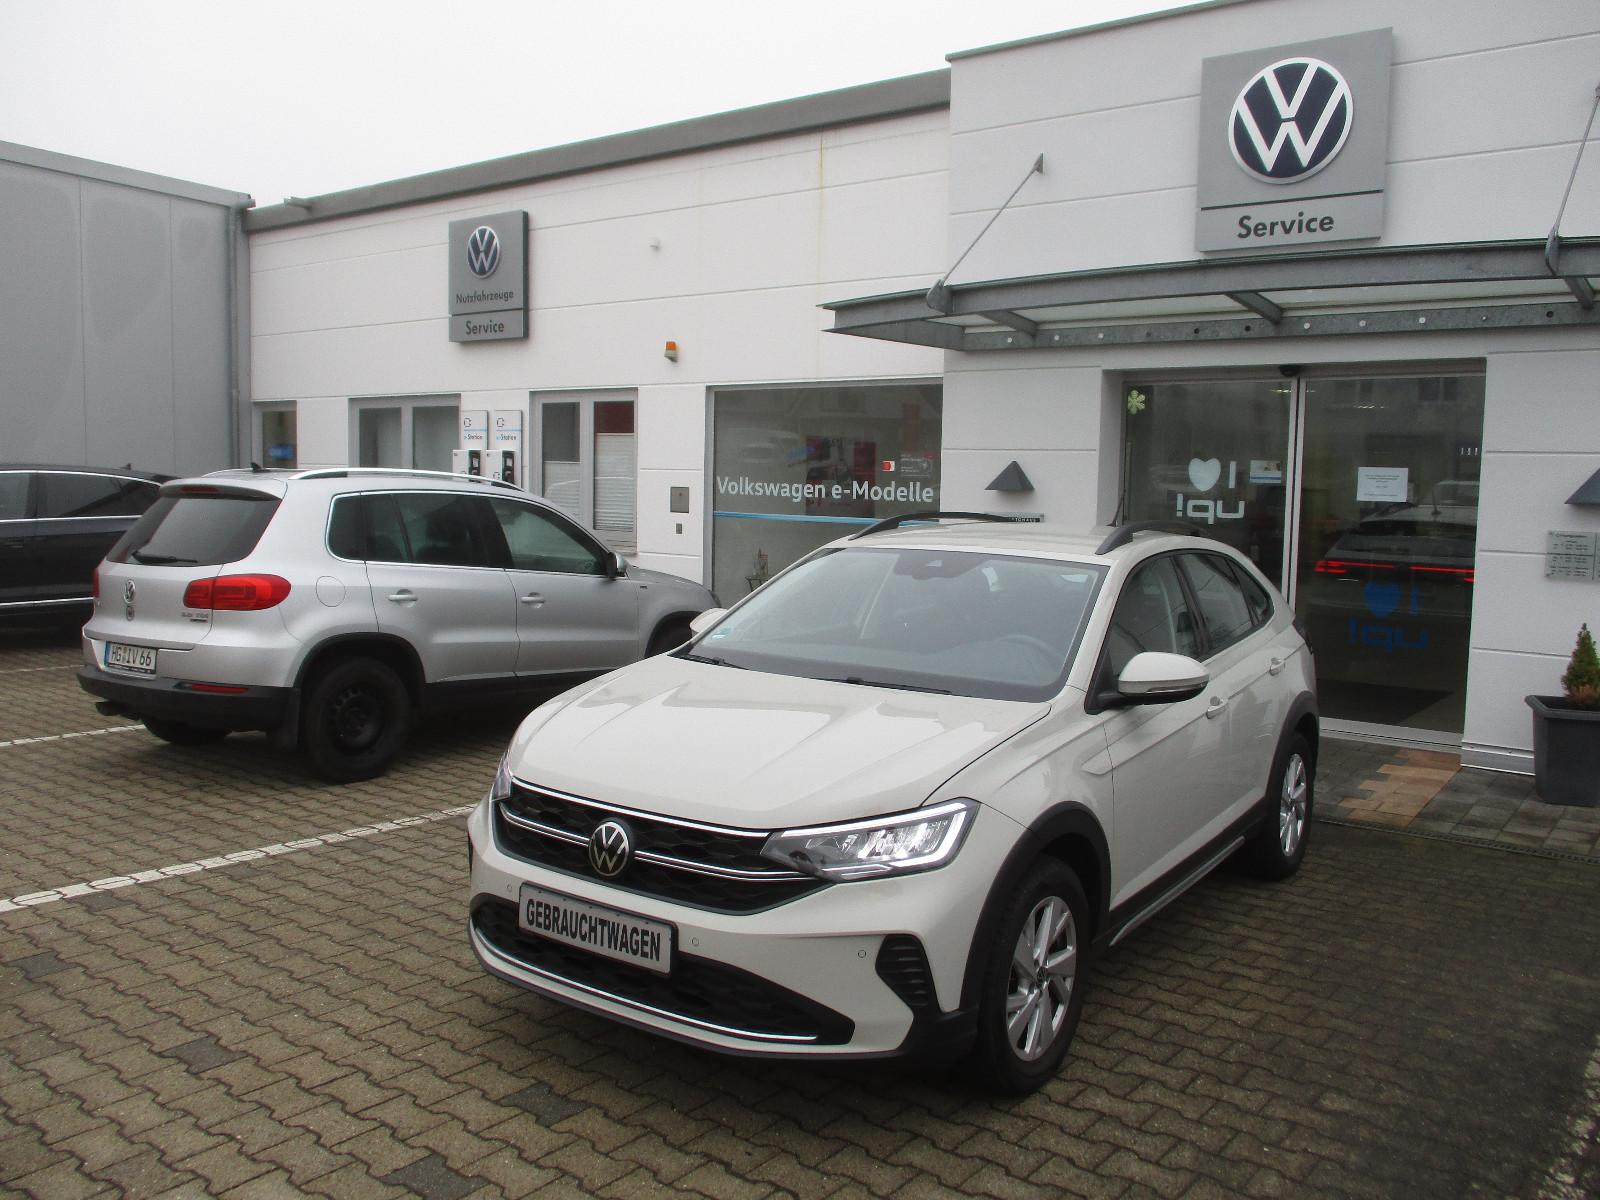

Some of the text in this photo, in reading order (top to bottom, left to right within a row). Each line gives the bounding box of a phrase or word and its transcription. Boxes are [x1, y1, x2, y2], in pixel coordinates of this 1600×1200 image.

[1237, 211, 1334, 238] Service
[456, 289, 514, 304] Nutzfahrzeuge
[465, 320, 505, 335] Service
[717, 476, 934, 503] Volkswagen e-Modelle
[139, 650, 151, 667] 66
[526, 899, 661, 962] GEBRAUCHTWAGEN
